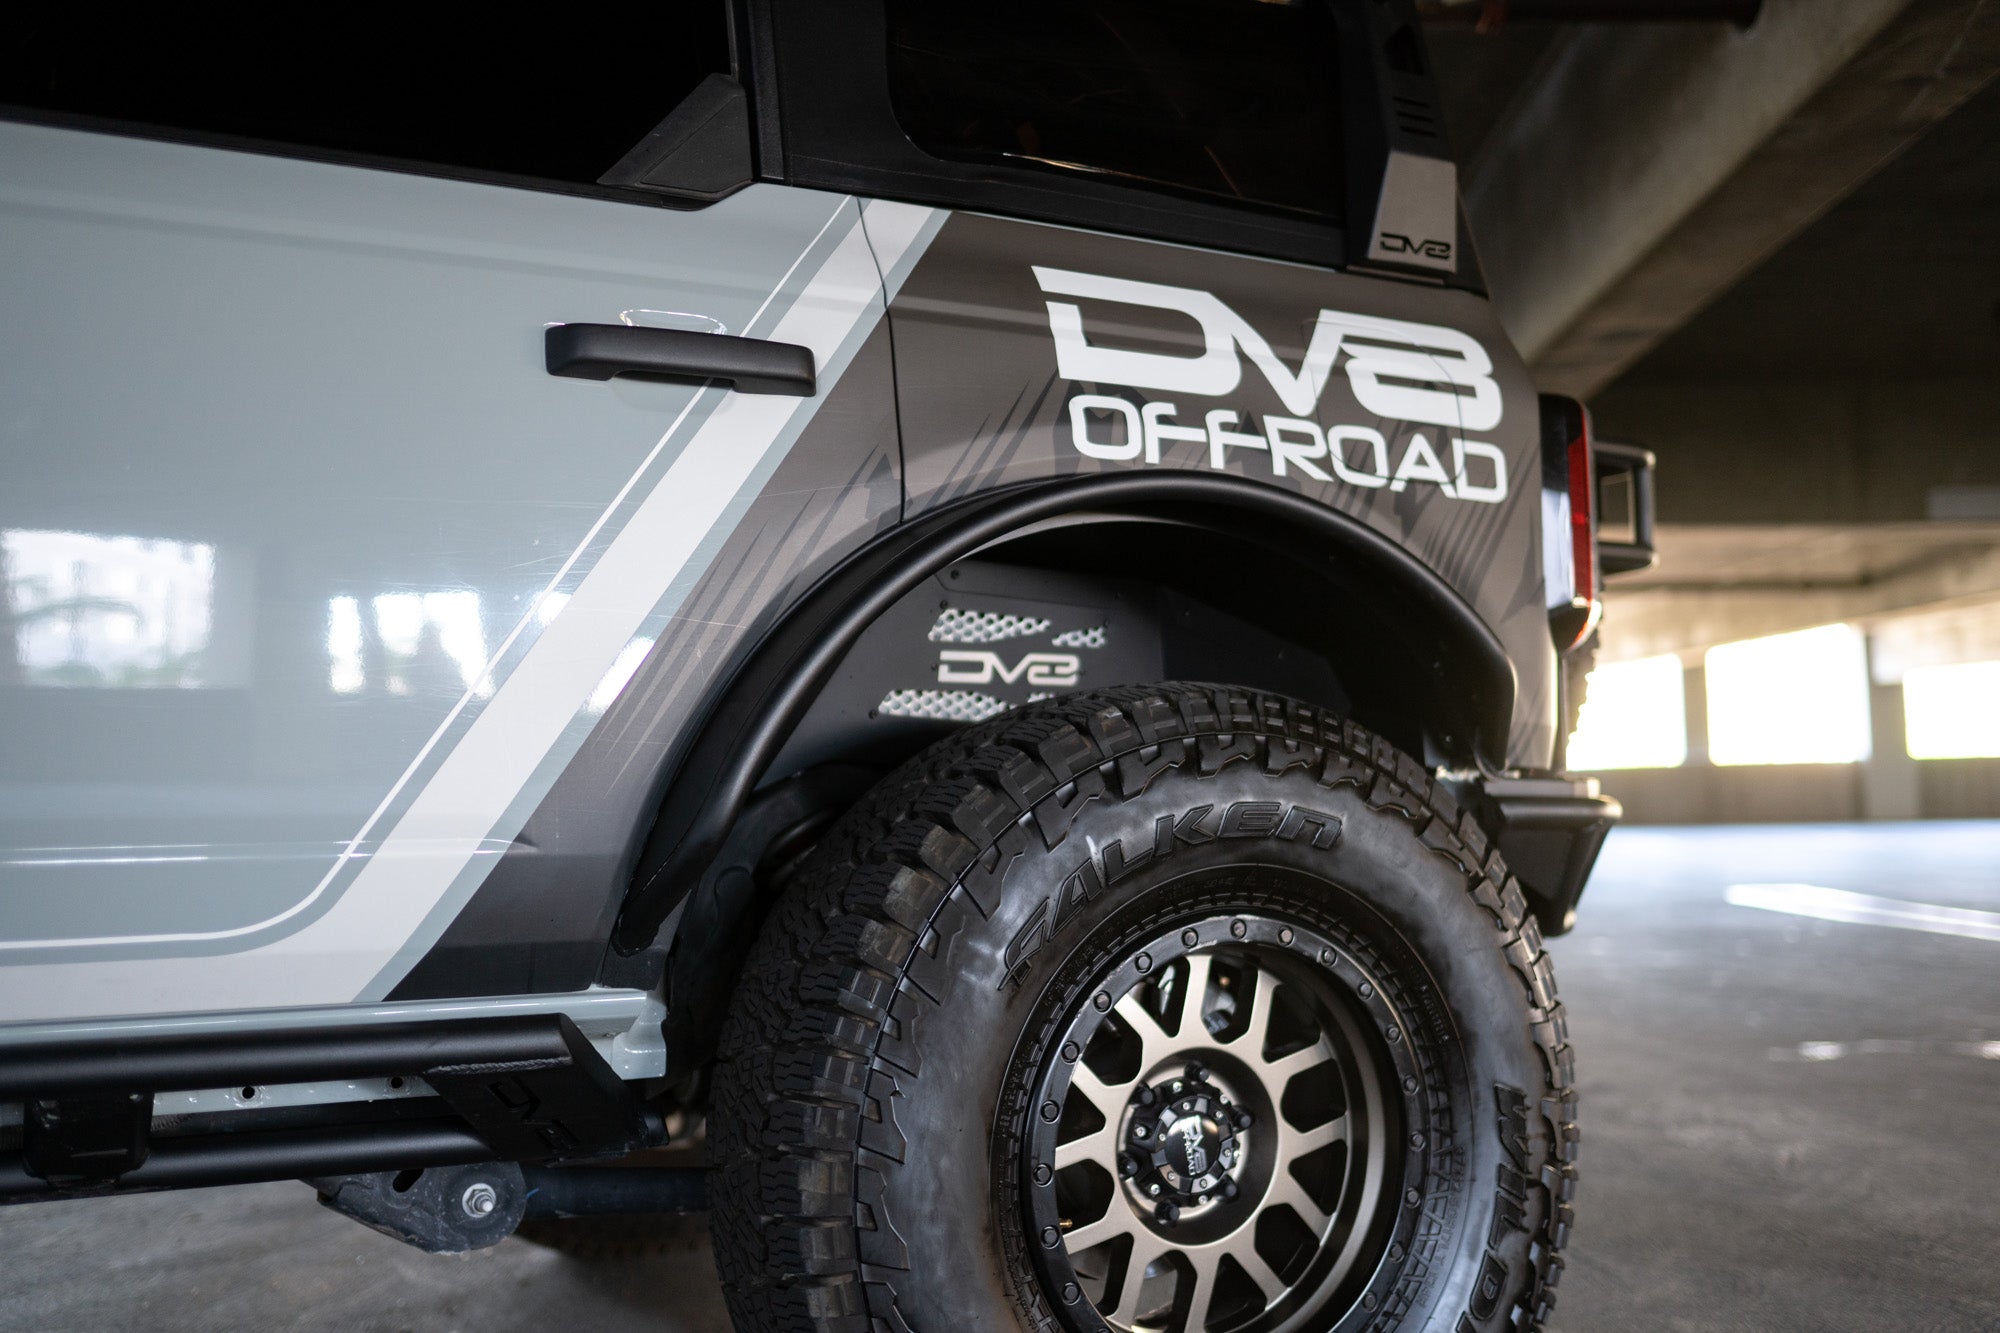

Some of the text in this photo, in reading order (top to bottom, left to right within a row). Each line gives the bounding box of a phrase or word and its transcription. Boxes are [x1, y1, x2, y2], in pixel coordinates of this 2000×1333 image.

[1381, 232, 1452, 260] DV8
[1031, 265, 1503, 431] DV8
[937, 649, 1080, 686] DV8
[1456, 1081, 1532, 1333] WILD
